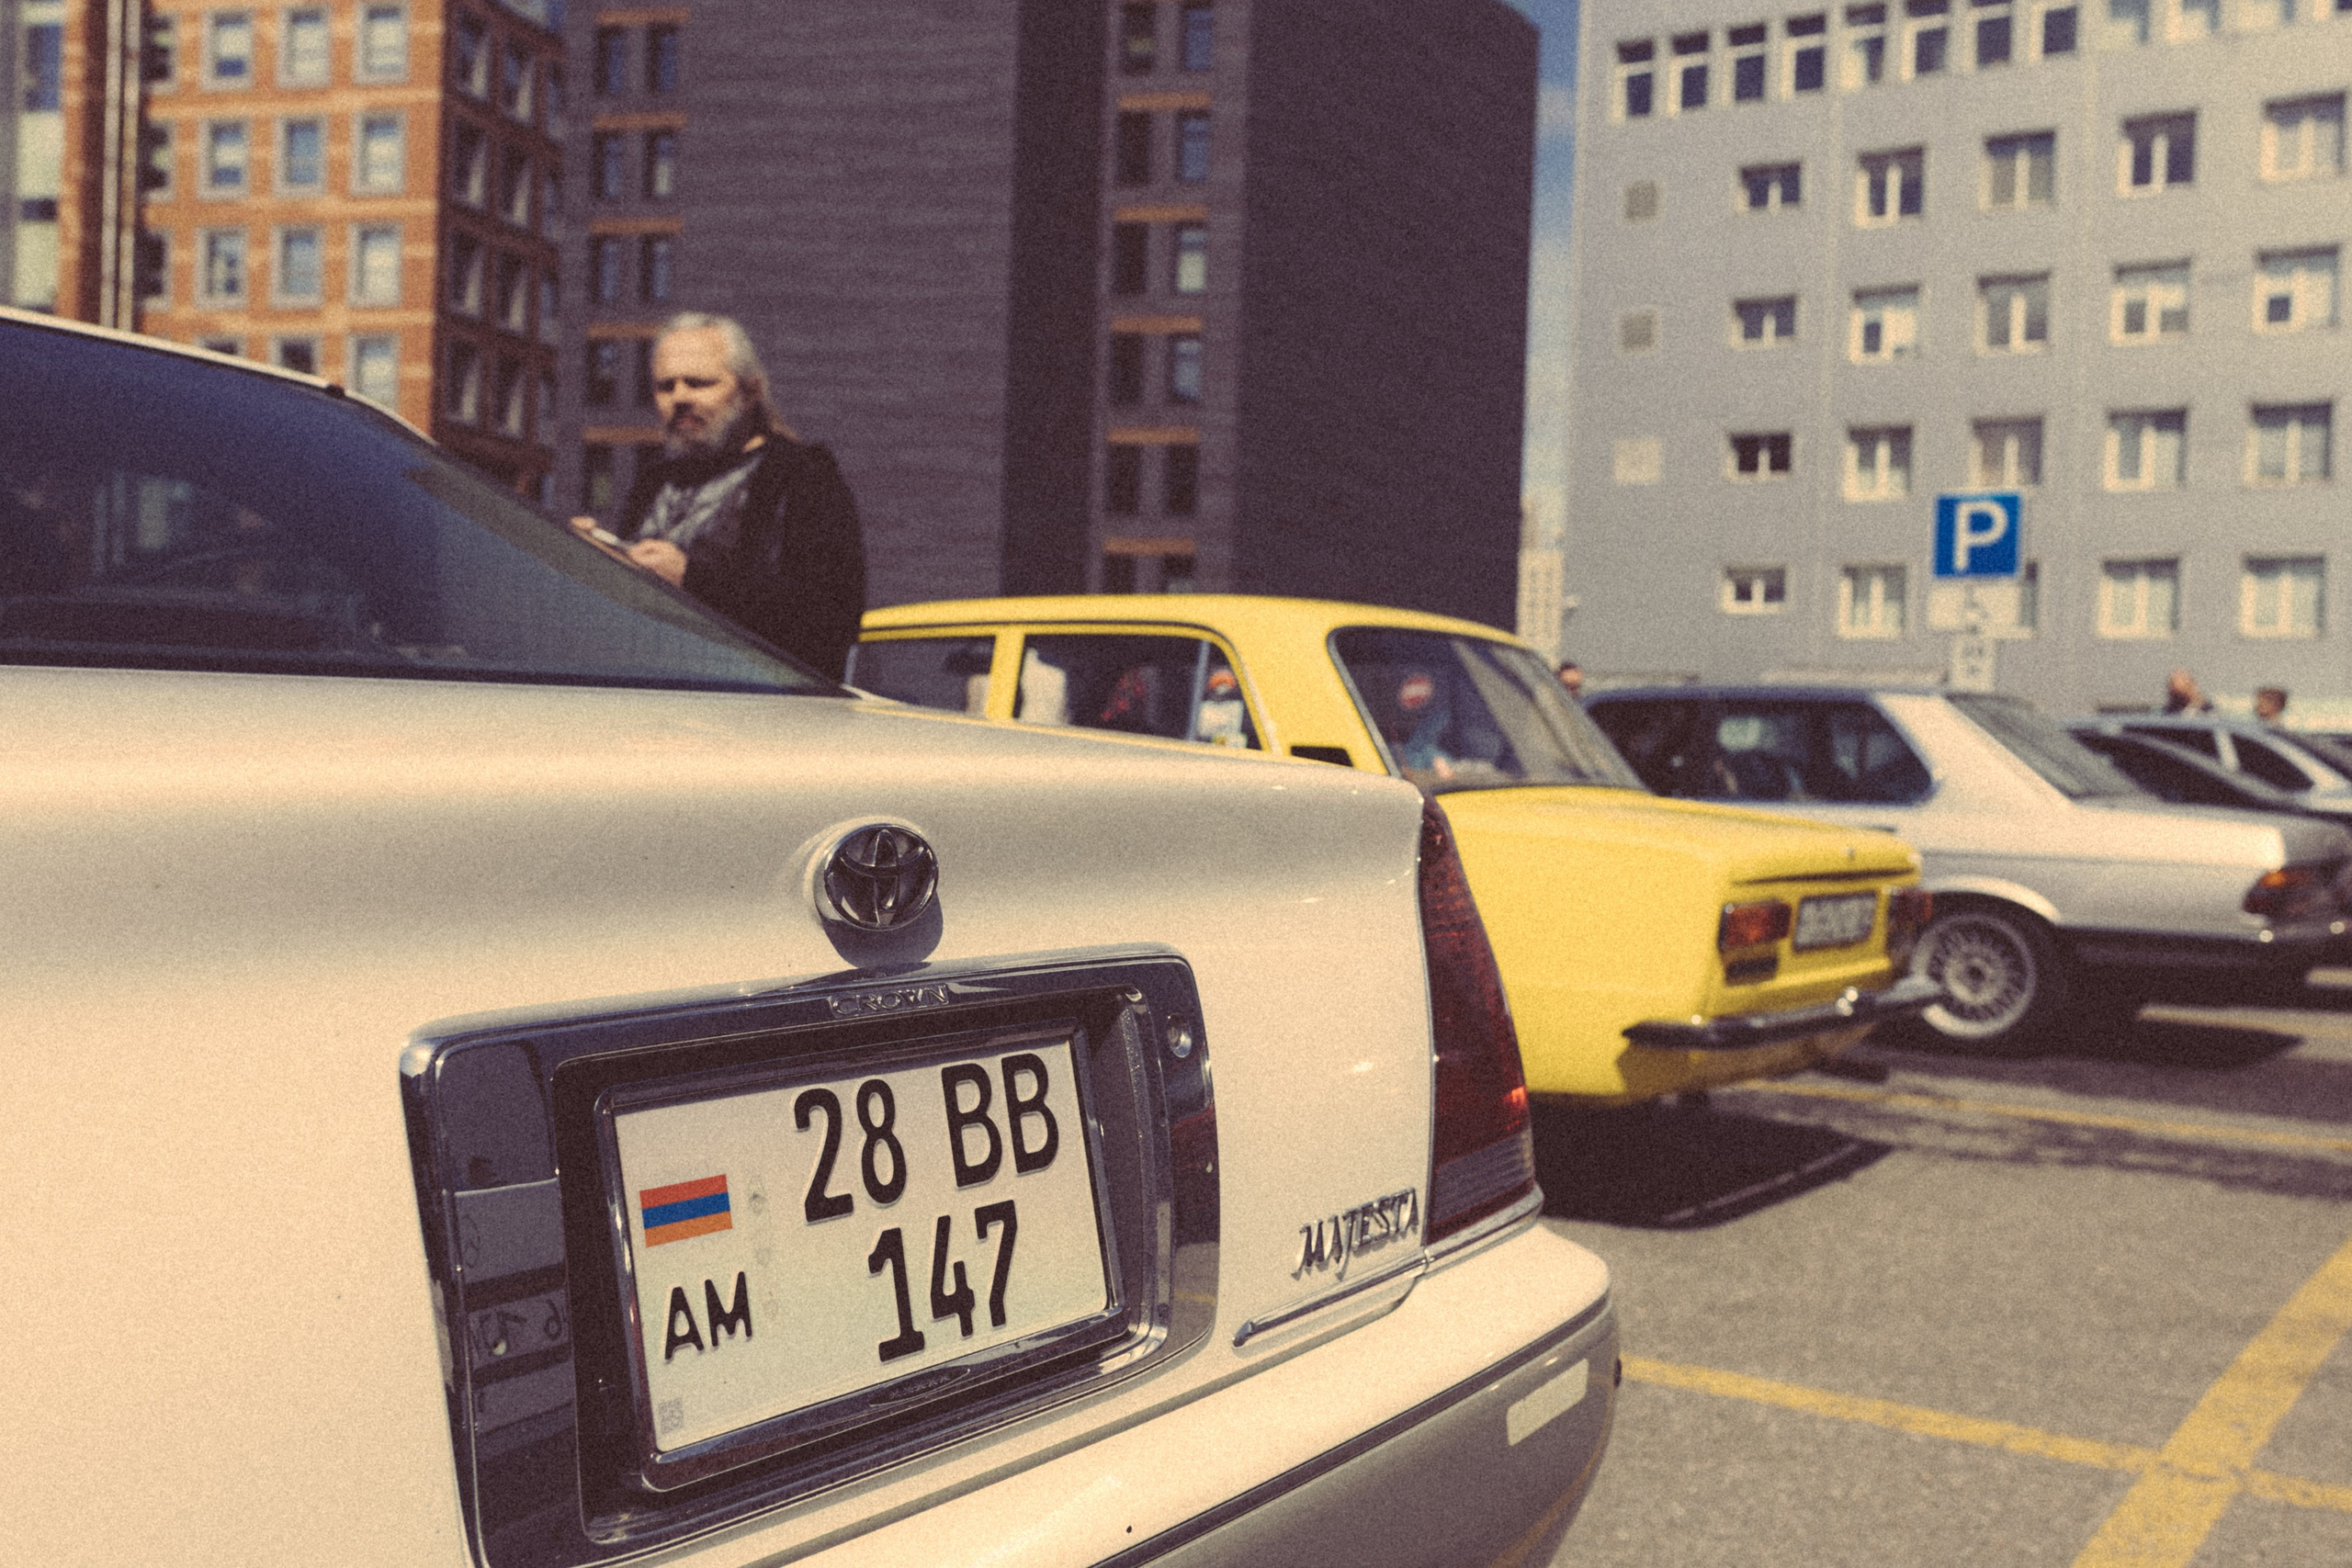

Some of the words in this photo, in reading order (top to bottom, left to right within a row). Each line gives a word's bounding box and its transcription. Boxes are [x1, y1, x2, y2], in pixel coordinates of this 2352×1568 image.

[1954, 502, 2007, 570] P
[832, 984, 949, 1015] CROWN
[793, 1079, 908, 1224] 28
[941, 1053, 1059, 1189] BB
[1292, 1188, 1419, 1280] MAJESTA
[663, 1271, 753, 1361] AM
[867, 1200, 1018, 1362] 147
